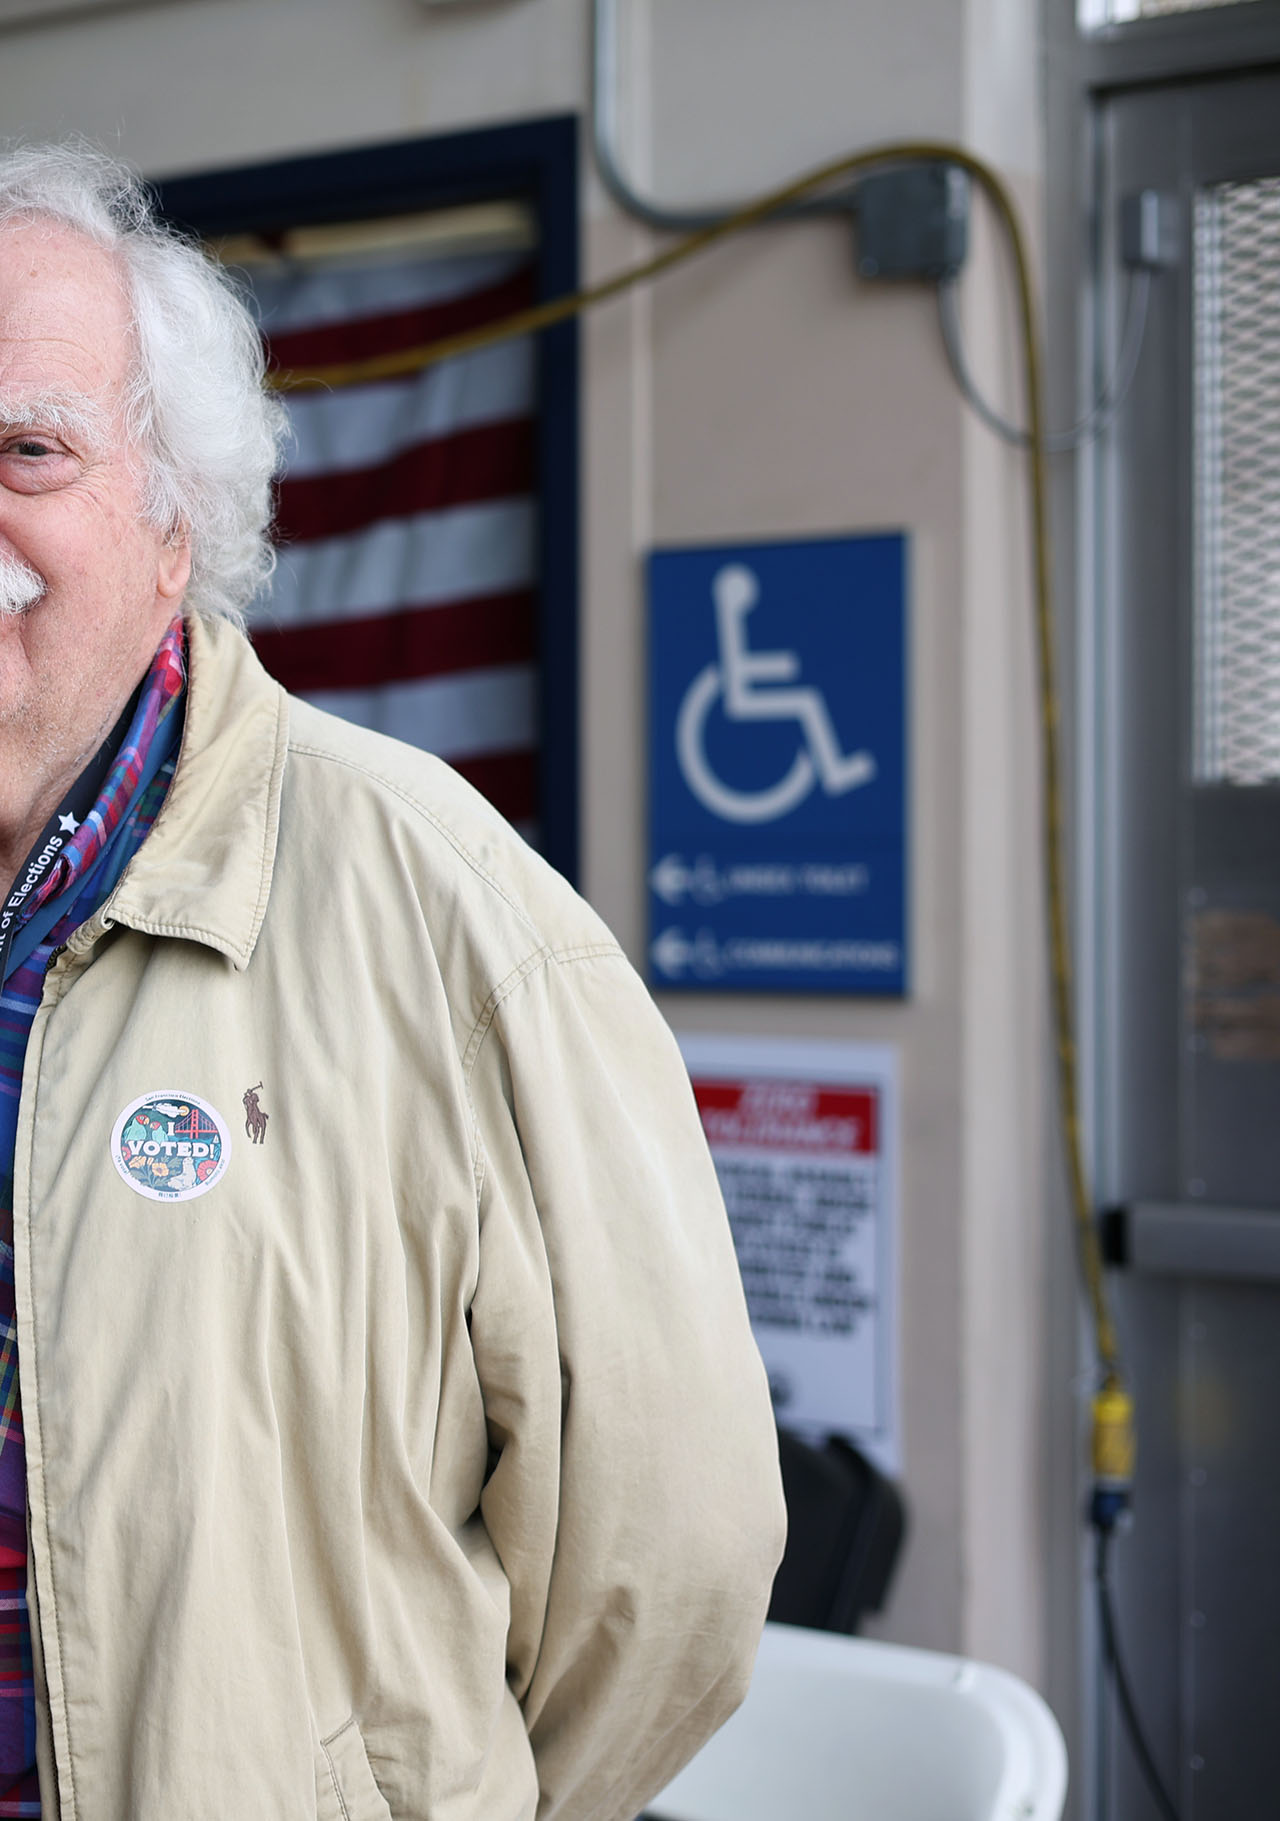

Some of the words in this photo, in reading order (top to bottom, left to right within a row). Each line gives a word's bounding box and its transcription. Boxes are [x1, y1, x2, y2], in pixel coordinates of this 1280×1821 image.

[7, 835, 63, 907] Elections
[1, 910, 15, 929] of
[167, 1121, 176, 1136] I
[127, 1140, 215, 1159] VOTED!
